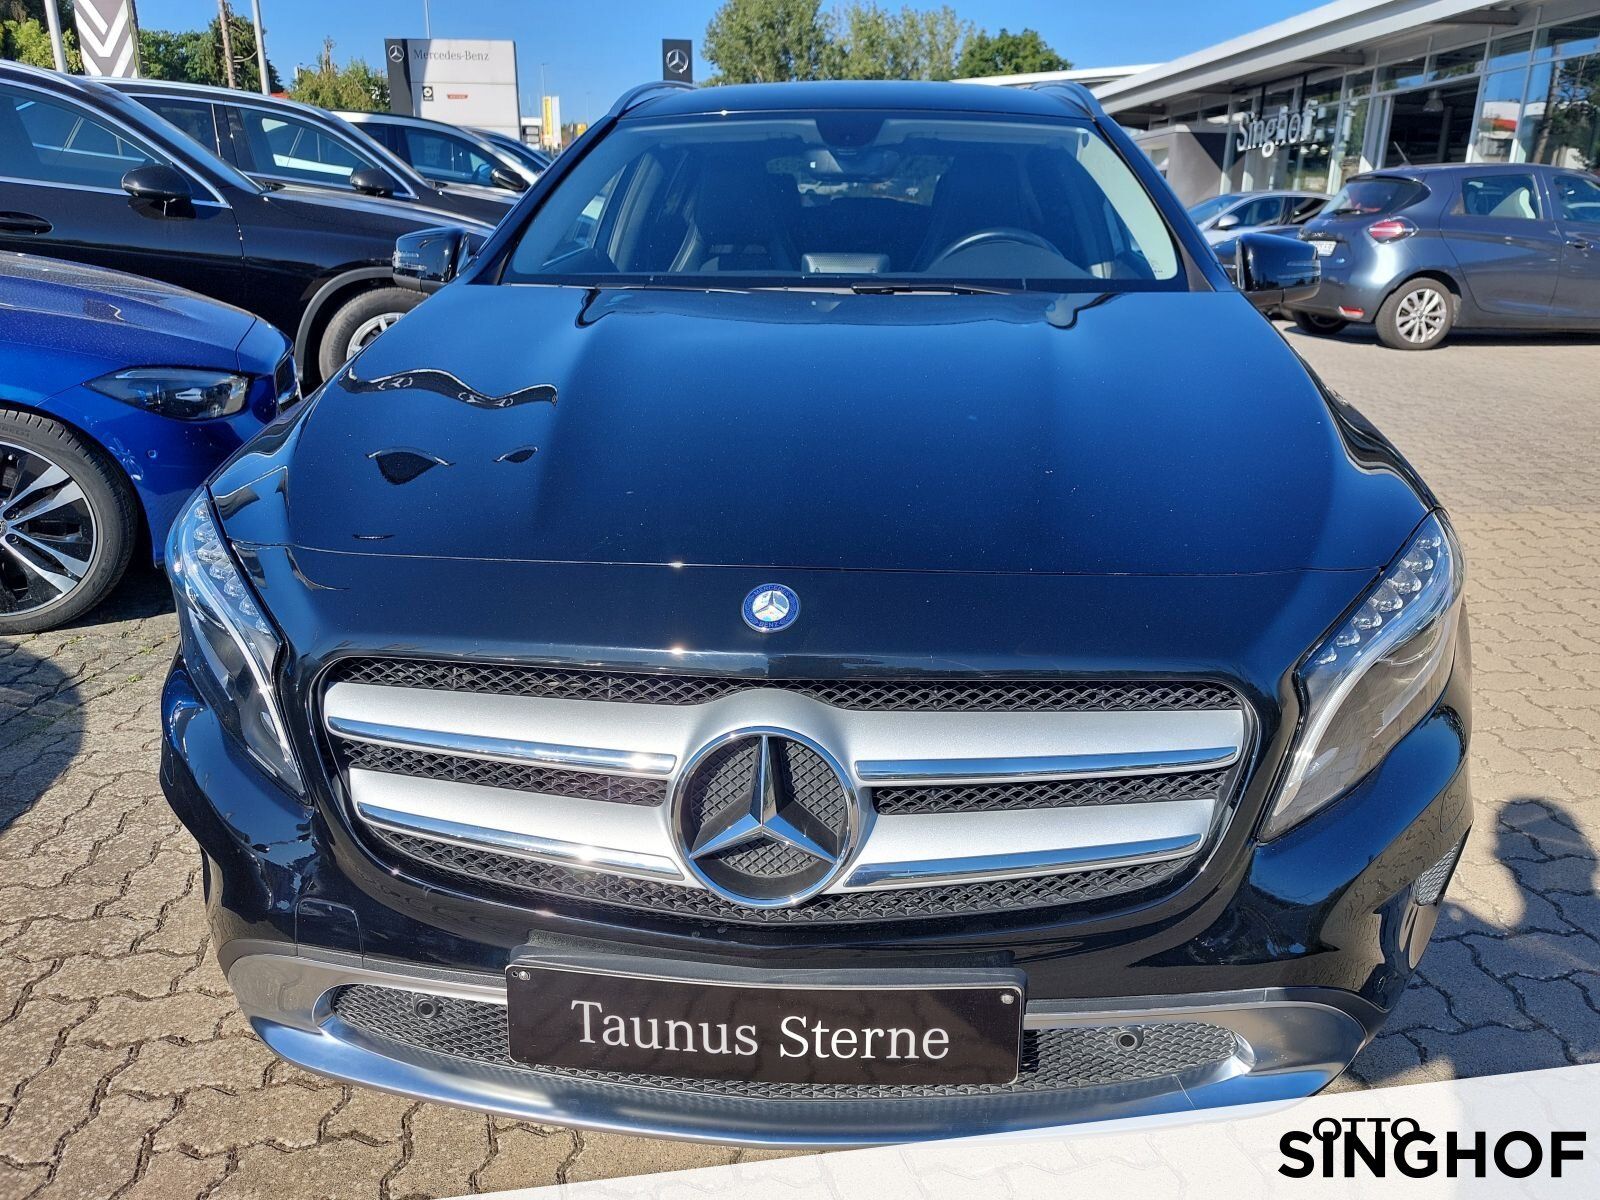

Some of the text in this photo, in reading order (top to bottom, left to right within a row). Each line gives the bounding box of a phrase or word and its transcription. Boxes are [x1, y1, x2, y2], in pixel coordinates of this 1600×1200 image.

[413, 48, 489, 61] Mercedes-Benz
[570, 999, 950, 1060] Taunus Sterne
